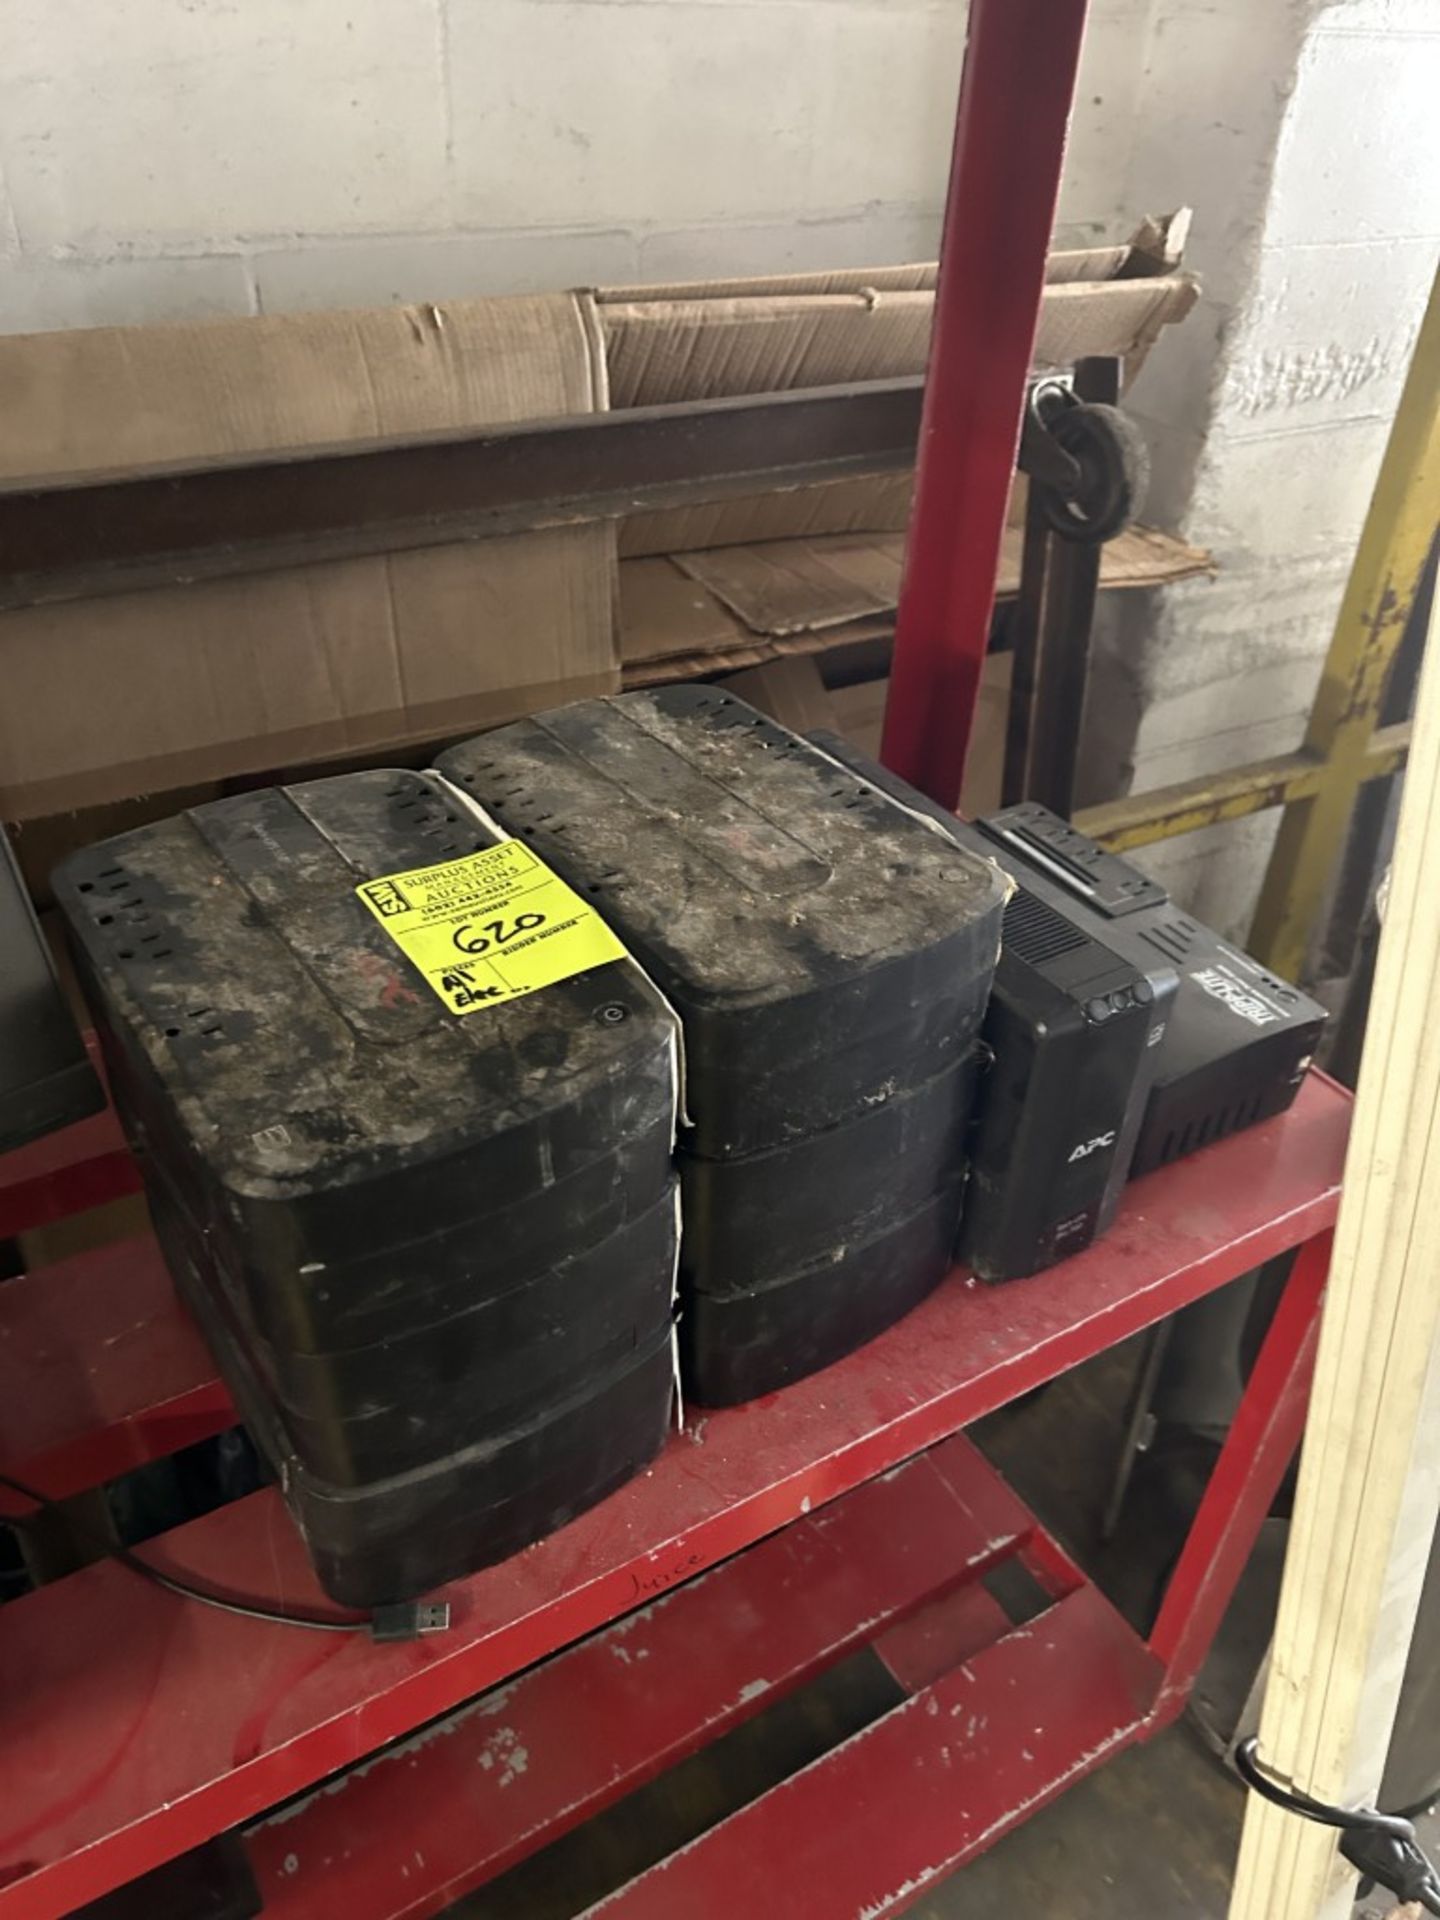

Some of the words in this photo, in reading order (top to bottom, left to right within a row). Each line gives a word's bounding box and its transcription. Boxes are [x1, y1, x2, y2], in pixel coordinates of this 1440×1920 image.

[403, 865, 468, 888] SURPLUS
[472, 847, 516, 870] ASSET
[426, 866, 519, 902] AUCTIONS
[452, 913, 546, 954] 620
[1067, 1130, 1116, 1163] APC
